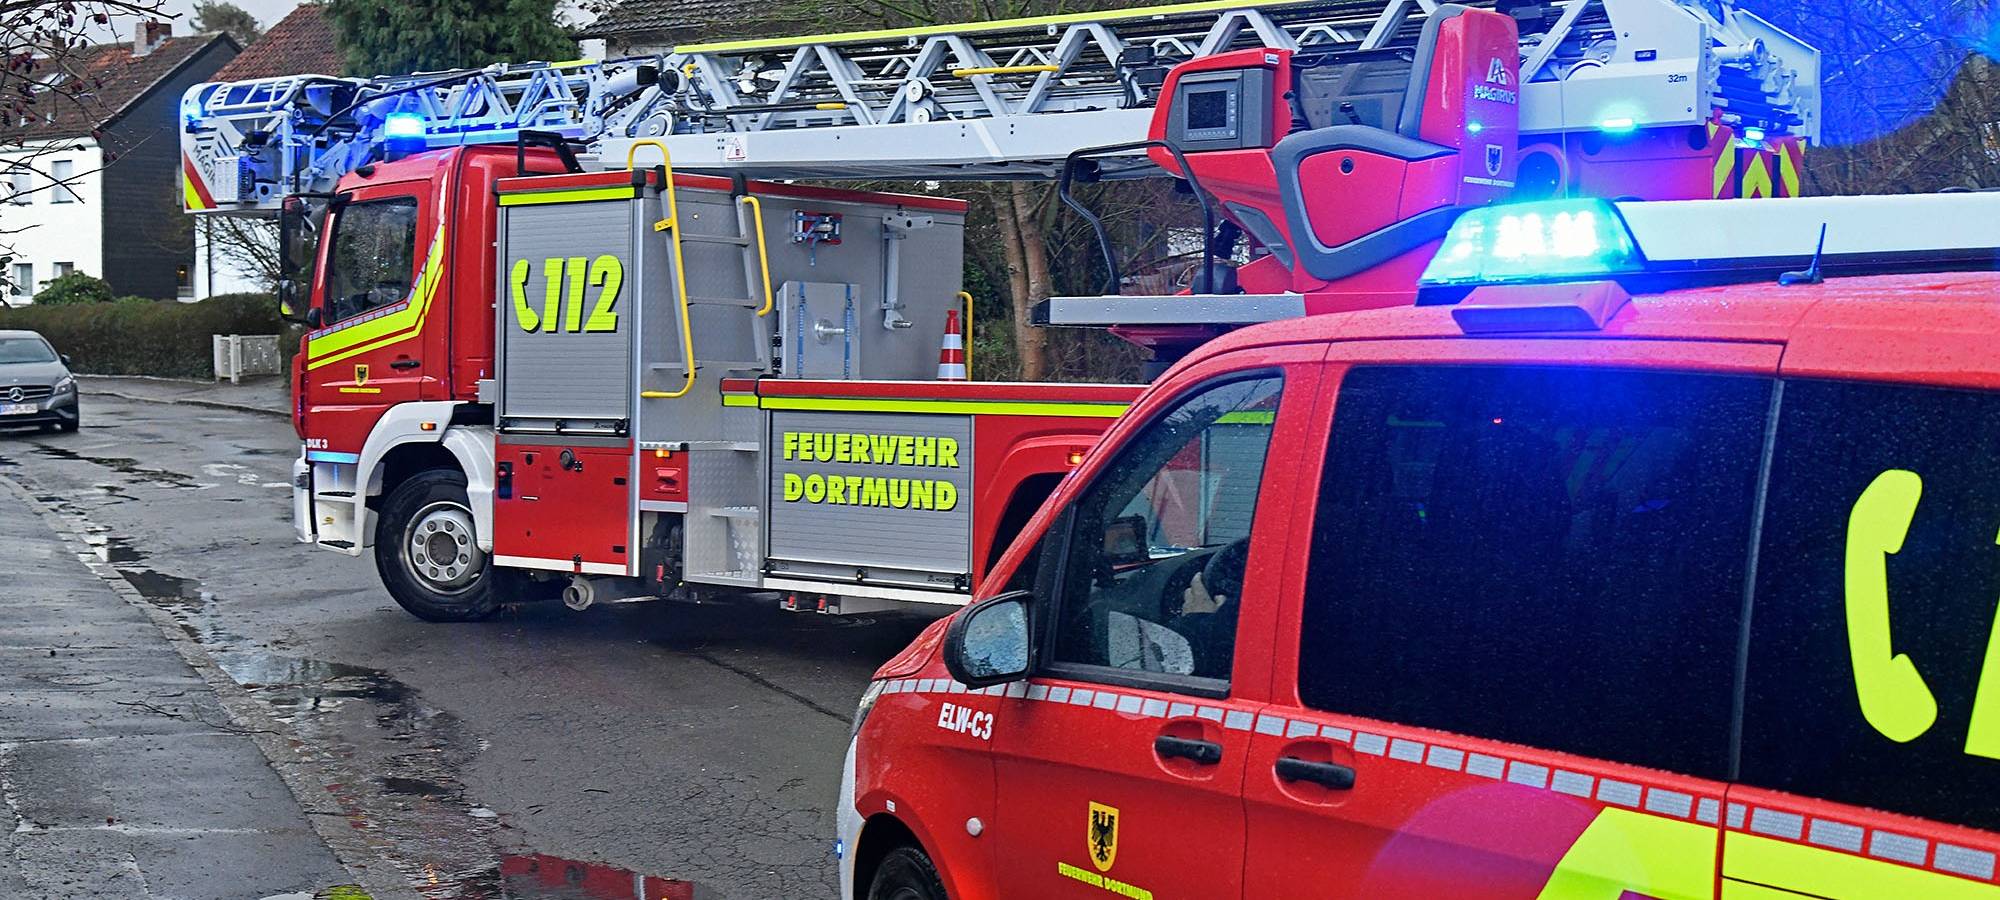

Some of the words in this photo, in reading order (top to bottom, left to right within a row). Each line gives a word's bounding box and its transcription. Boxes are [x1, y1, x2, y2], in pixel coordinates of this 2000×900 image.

[1473, 84, 1516, 105] MAGIRUS
[1667, 74, 1688, 83] 32m
[541, 254, 624, 333] 112
[322, 438, 328, 449] 3
[783, 432, 959, 468] FEUERWEHR
[783, 473, 959, 510] DORTMUND
[937, 702, 994, 740] ELW-C3
[1058, 862, 1104, 889] FEUERWEHR
[1104, 877, 1154, 900] DORTMUND
